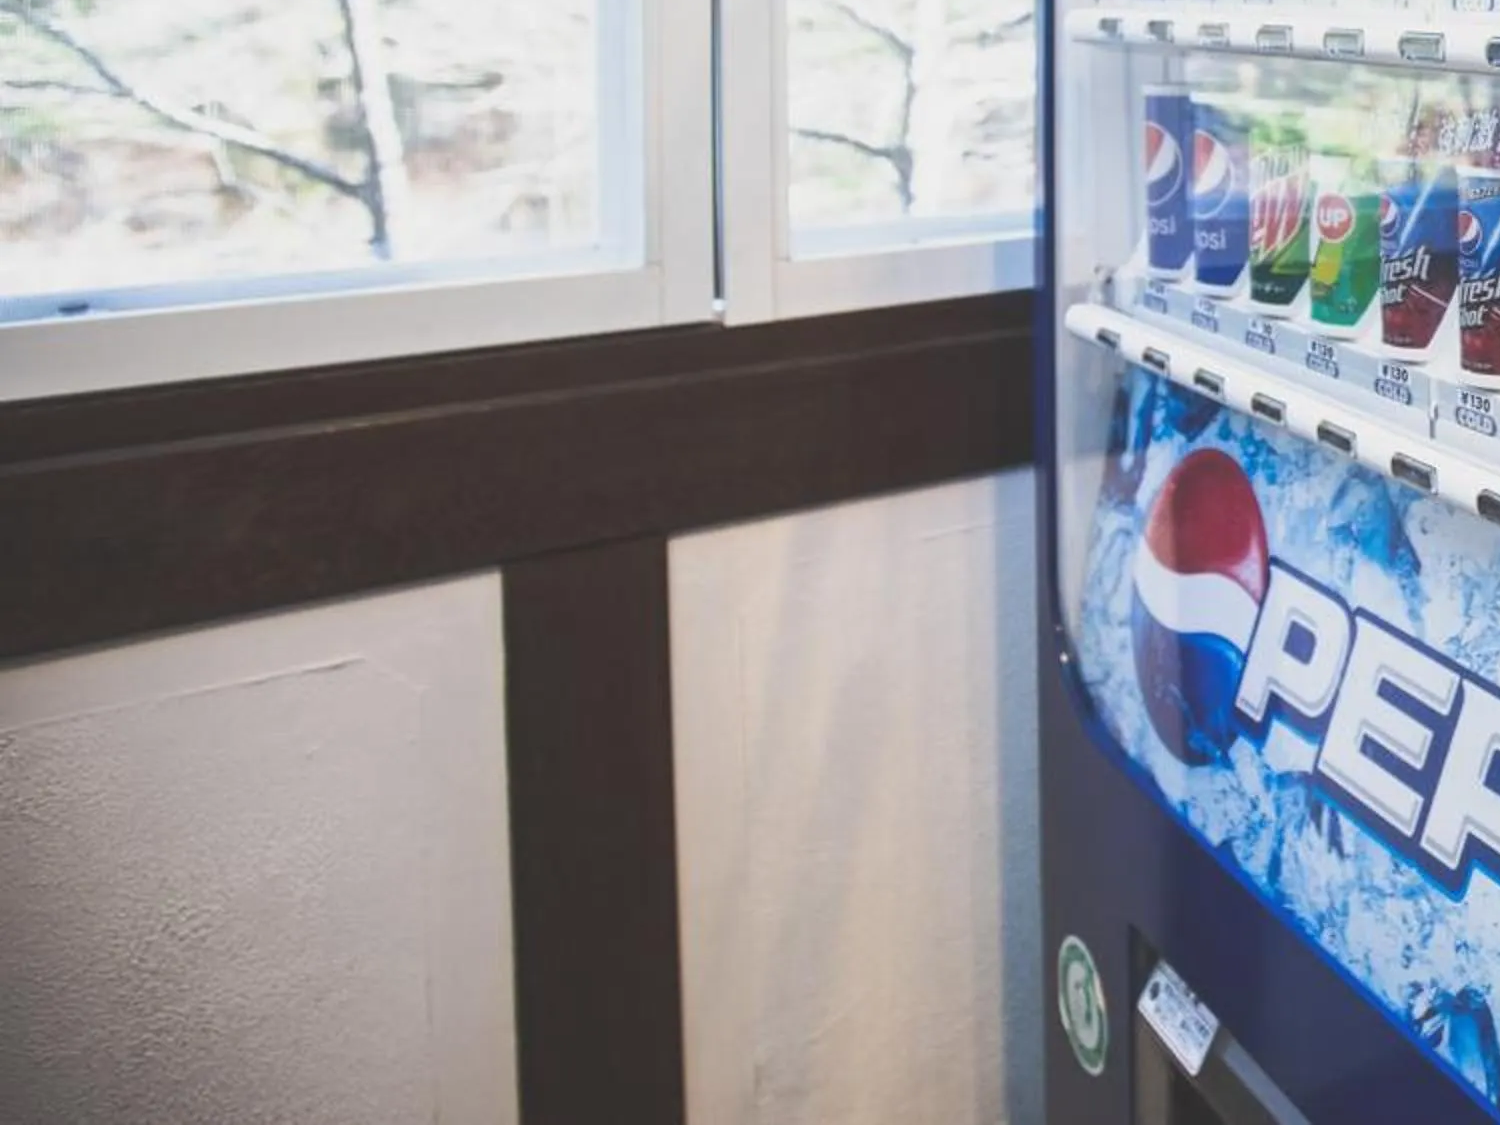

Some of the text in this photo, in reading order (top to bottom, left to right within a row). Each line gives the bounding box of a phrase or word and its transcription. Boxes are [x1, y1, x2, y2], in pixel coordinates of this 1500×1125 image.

[1382, 364, 1409, 383] ¥130
[1460, 391, 1491, 413] ¥130
[1457, 408, 1494, 435] COLD
